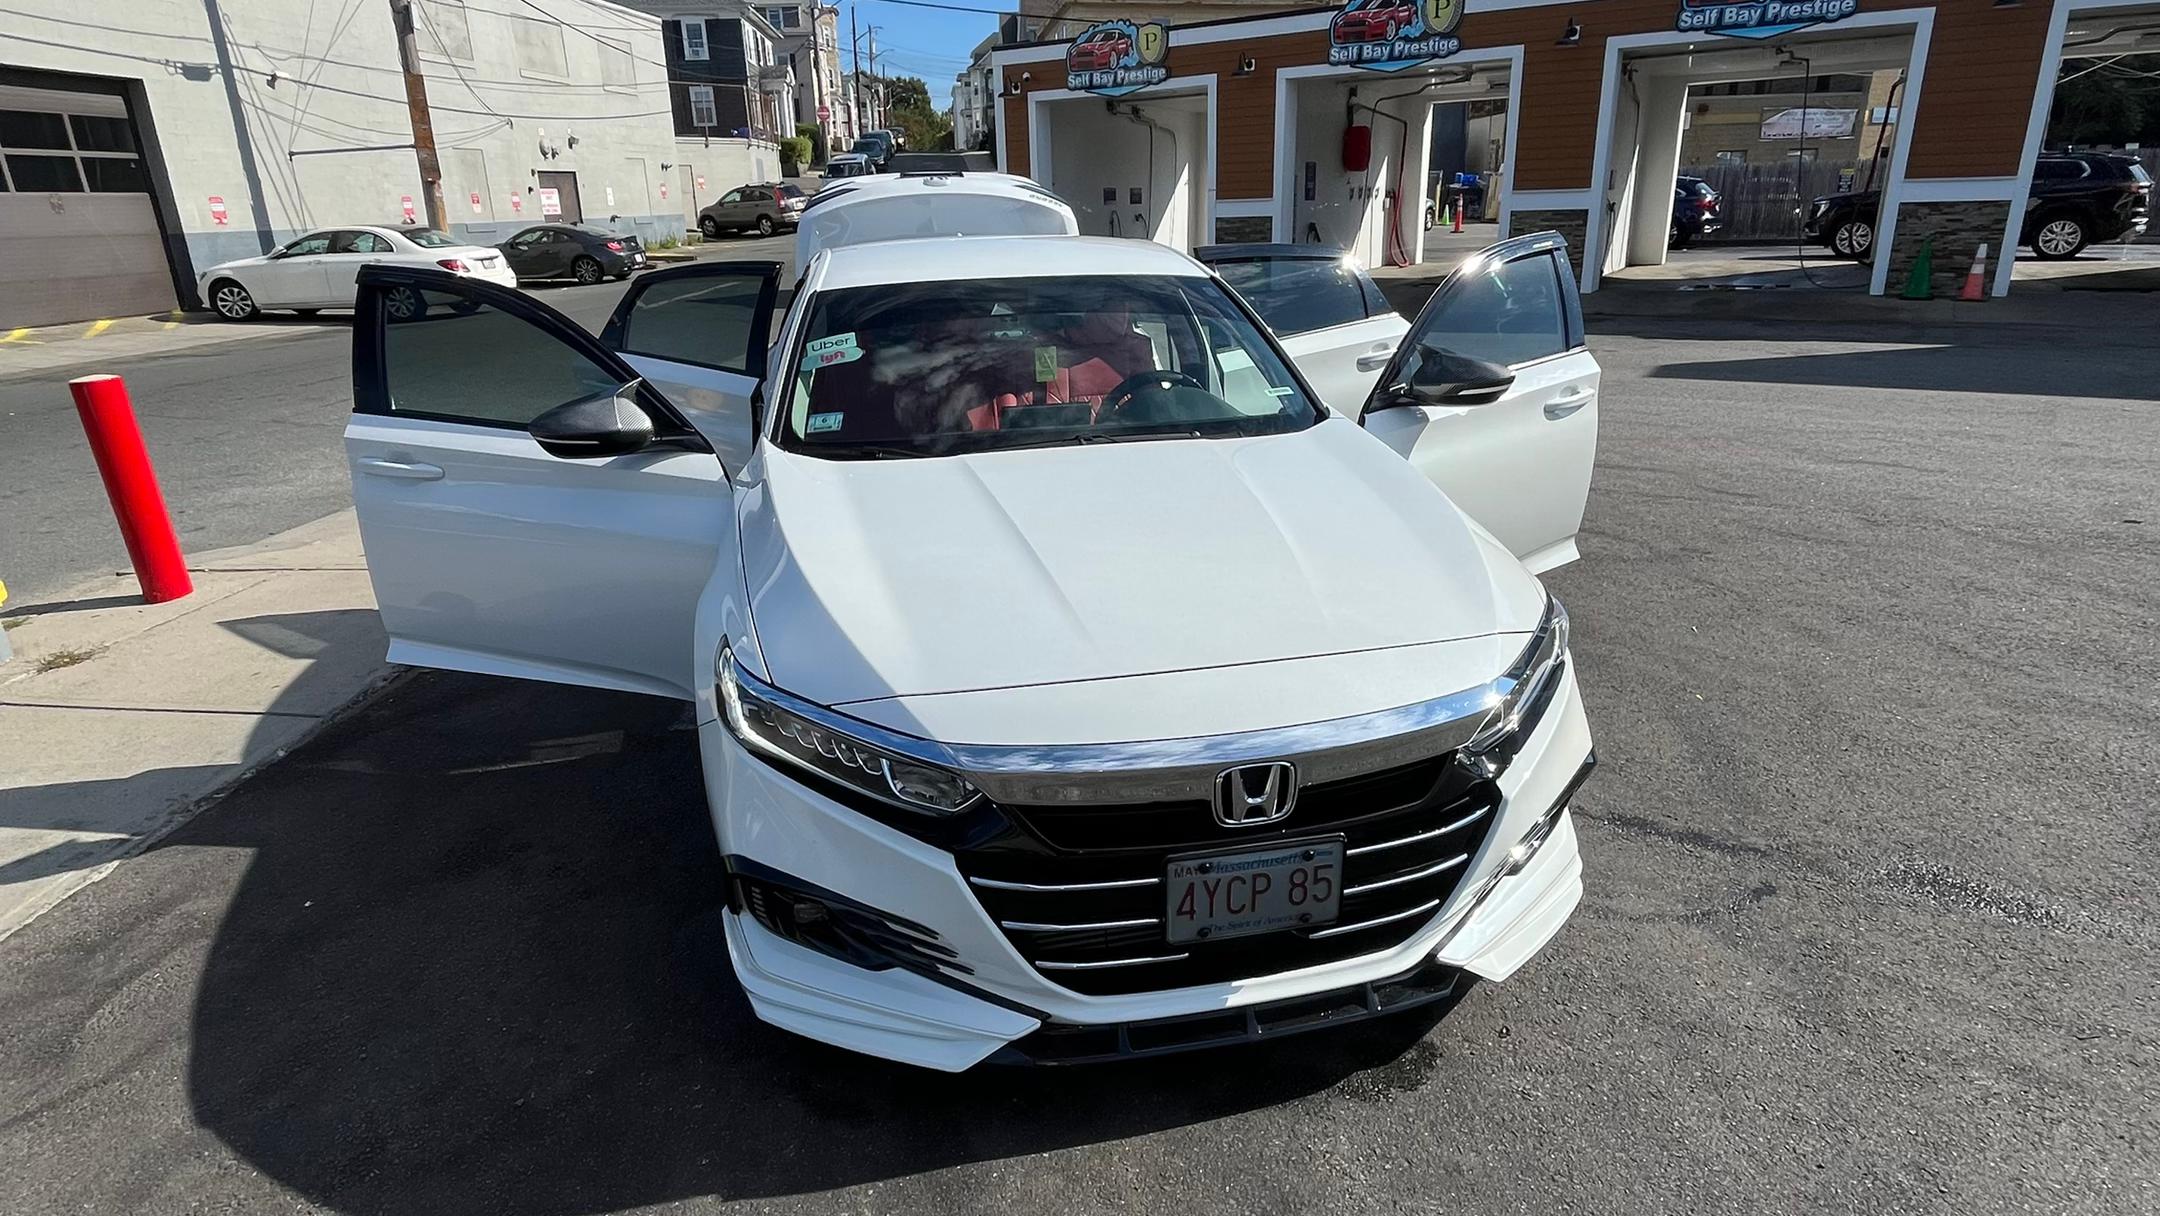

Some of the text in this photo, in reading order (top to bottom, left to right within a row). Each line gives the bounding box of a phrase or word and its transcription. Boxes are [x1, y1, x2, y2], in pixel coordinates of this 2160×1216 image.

[1433, 0, 1450, 19] P
[1680, 0, 1855, 27] Self Bay Prestige
[1144, 33, 1157, 50] P
[1330, 36, 1459, 61] Self Bay Prestige
[1068, 66, 1167, 87] Self Bay Prestige
[812, 337, 850, 352] Uber
[1176, 863, 1334, 920] 4YCP 85
